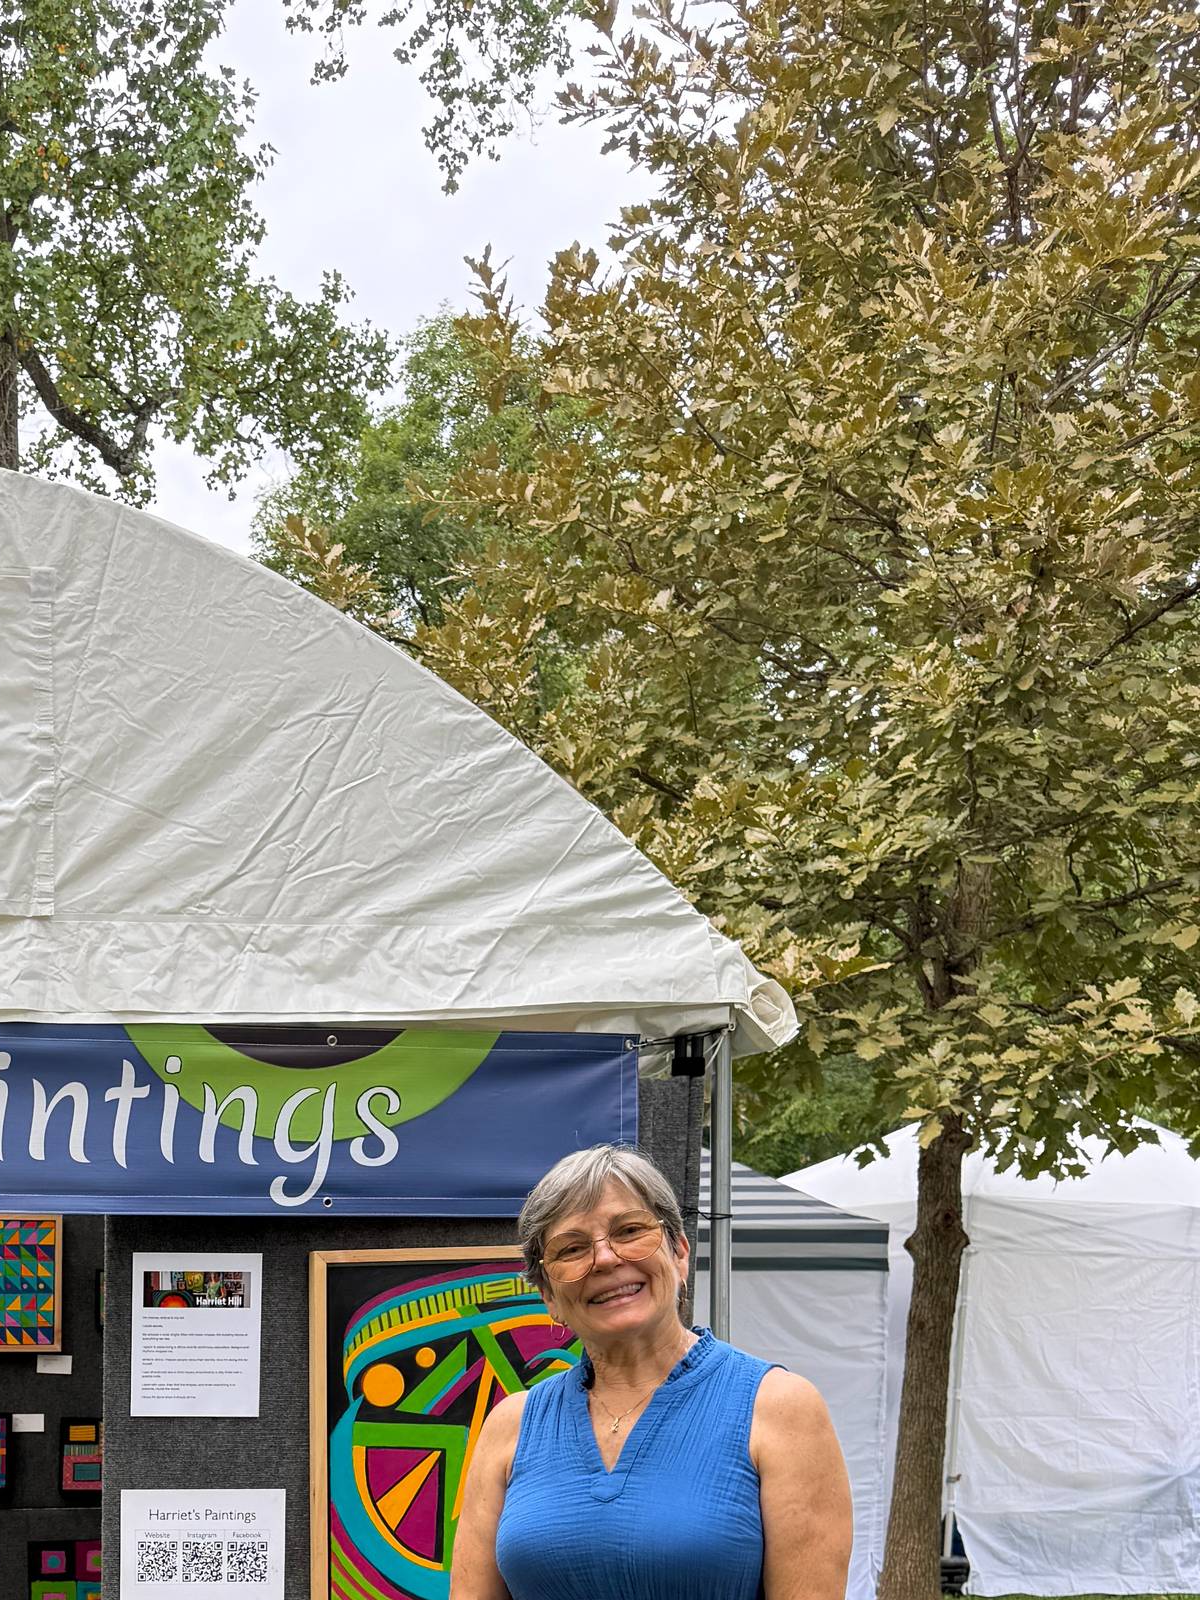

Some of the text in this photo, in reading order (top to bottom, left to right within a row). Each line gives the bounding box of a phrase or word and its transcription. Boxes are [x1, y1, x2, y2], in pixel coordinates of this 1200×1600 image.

[196, 1297, 242, 1306] Harriet Hill
[149, 1509, 256, 1523] Harriet's Paintings
